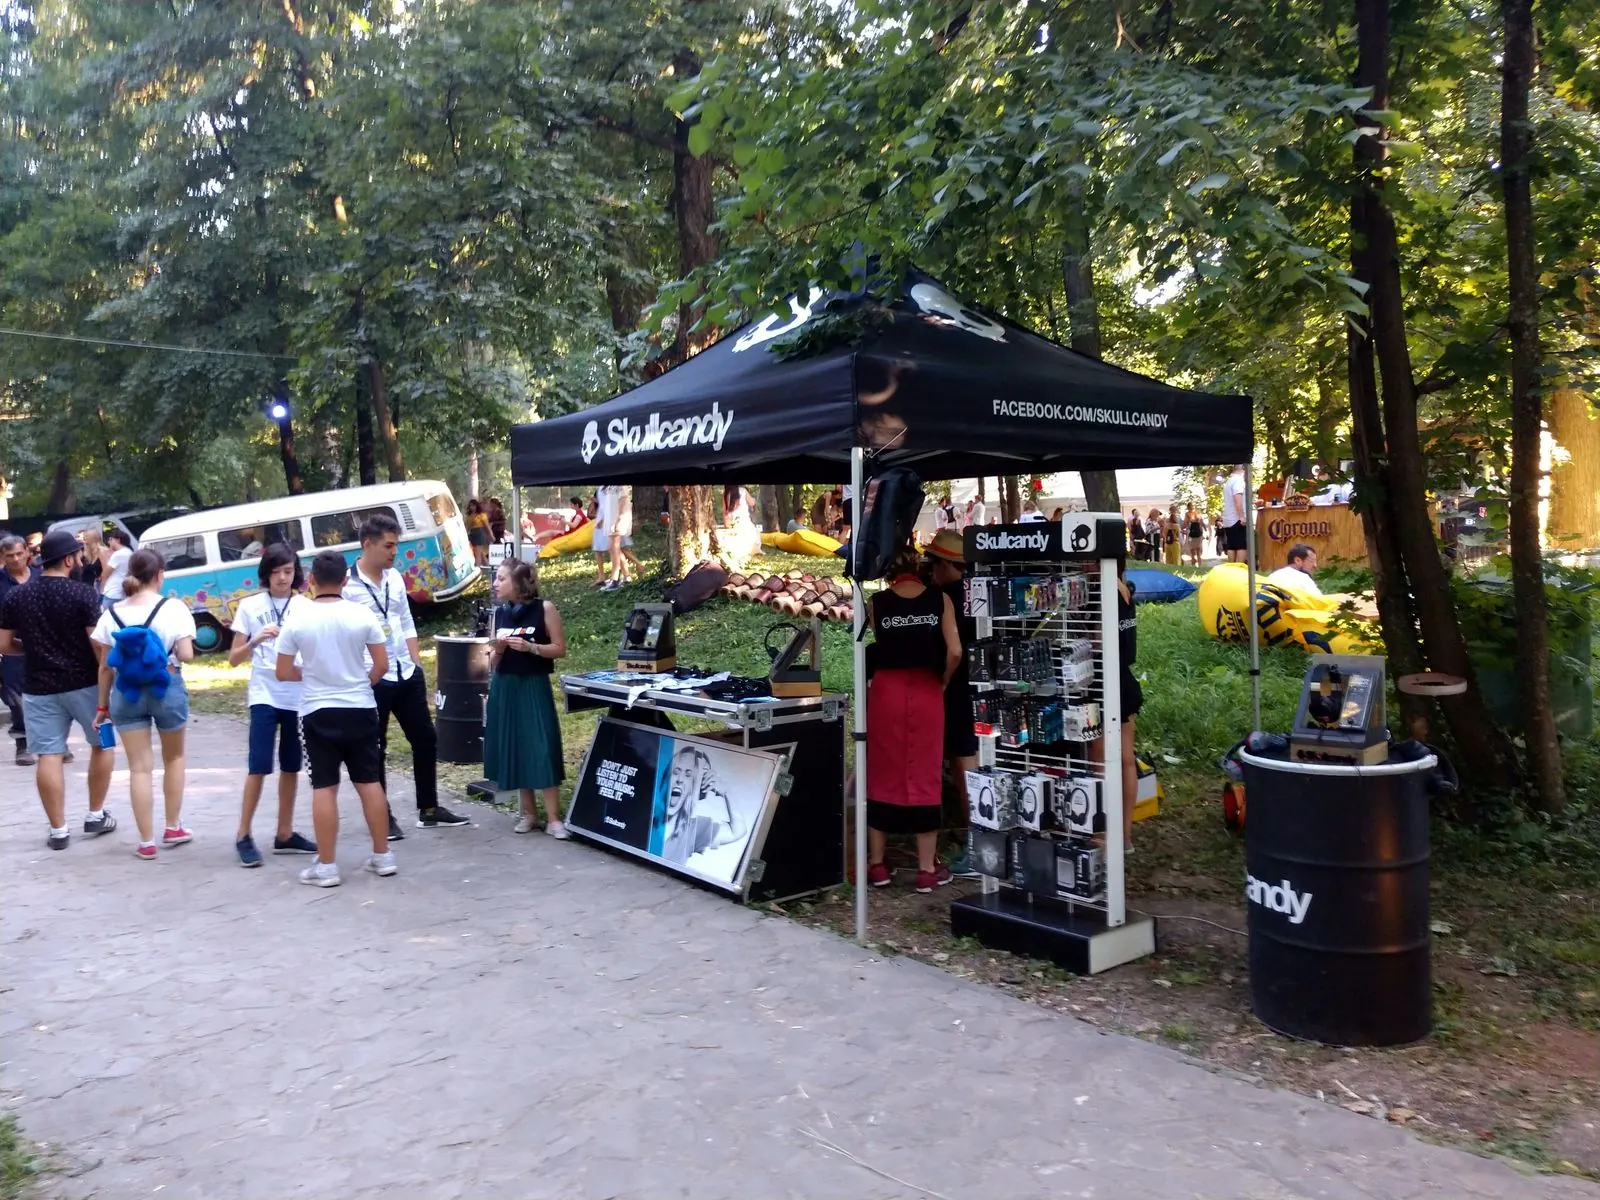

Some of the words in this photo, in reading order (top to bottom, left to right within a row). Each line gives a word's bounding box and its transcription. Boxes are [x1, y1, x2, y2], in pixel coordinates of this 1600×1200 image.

[992, 399, 1168, 428] FACEBOOK.COM/SKULLCANDY
[604, 401, 734, 457] Skullcandy
[975, 530, 1050, 552] Skullcandy
[1267, 516, 1332, 544] Corona
